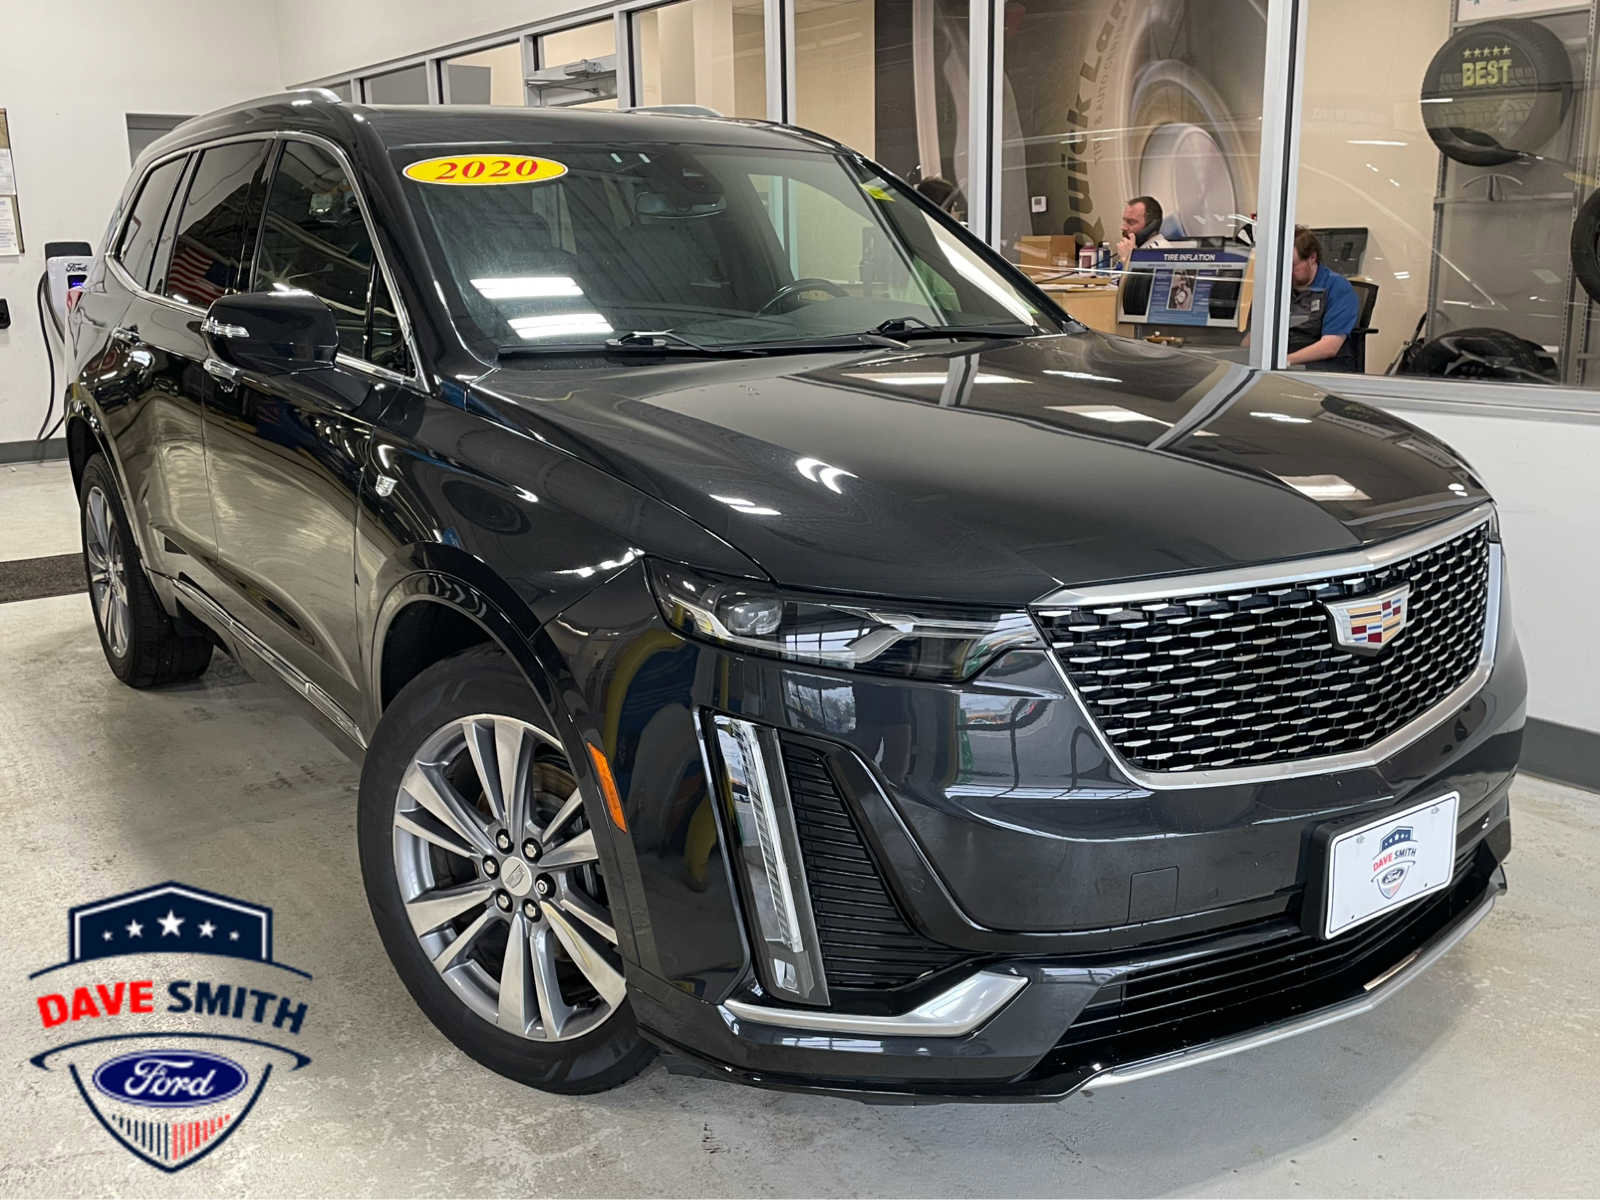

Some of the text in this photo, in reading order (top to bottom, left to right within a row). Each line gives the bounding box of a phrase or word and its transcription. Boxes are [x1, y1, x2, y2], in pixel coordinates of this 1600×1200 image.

[1462, 59, 1512, 87] BEST
[435, 160, 538, 180] 2020
[66, 262, 88, 272] Ford
[1164, 253, 1216, 262] TIRE INFLATION
[1373, 847, 1417, 872] DAVE SMITH
